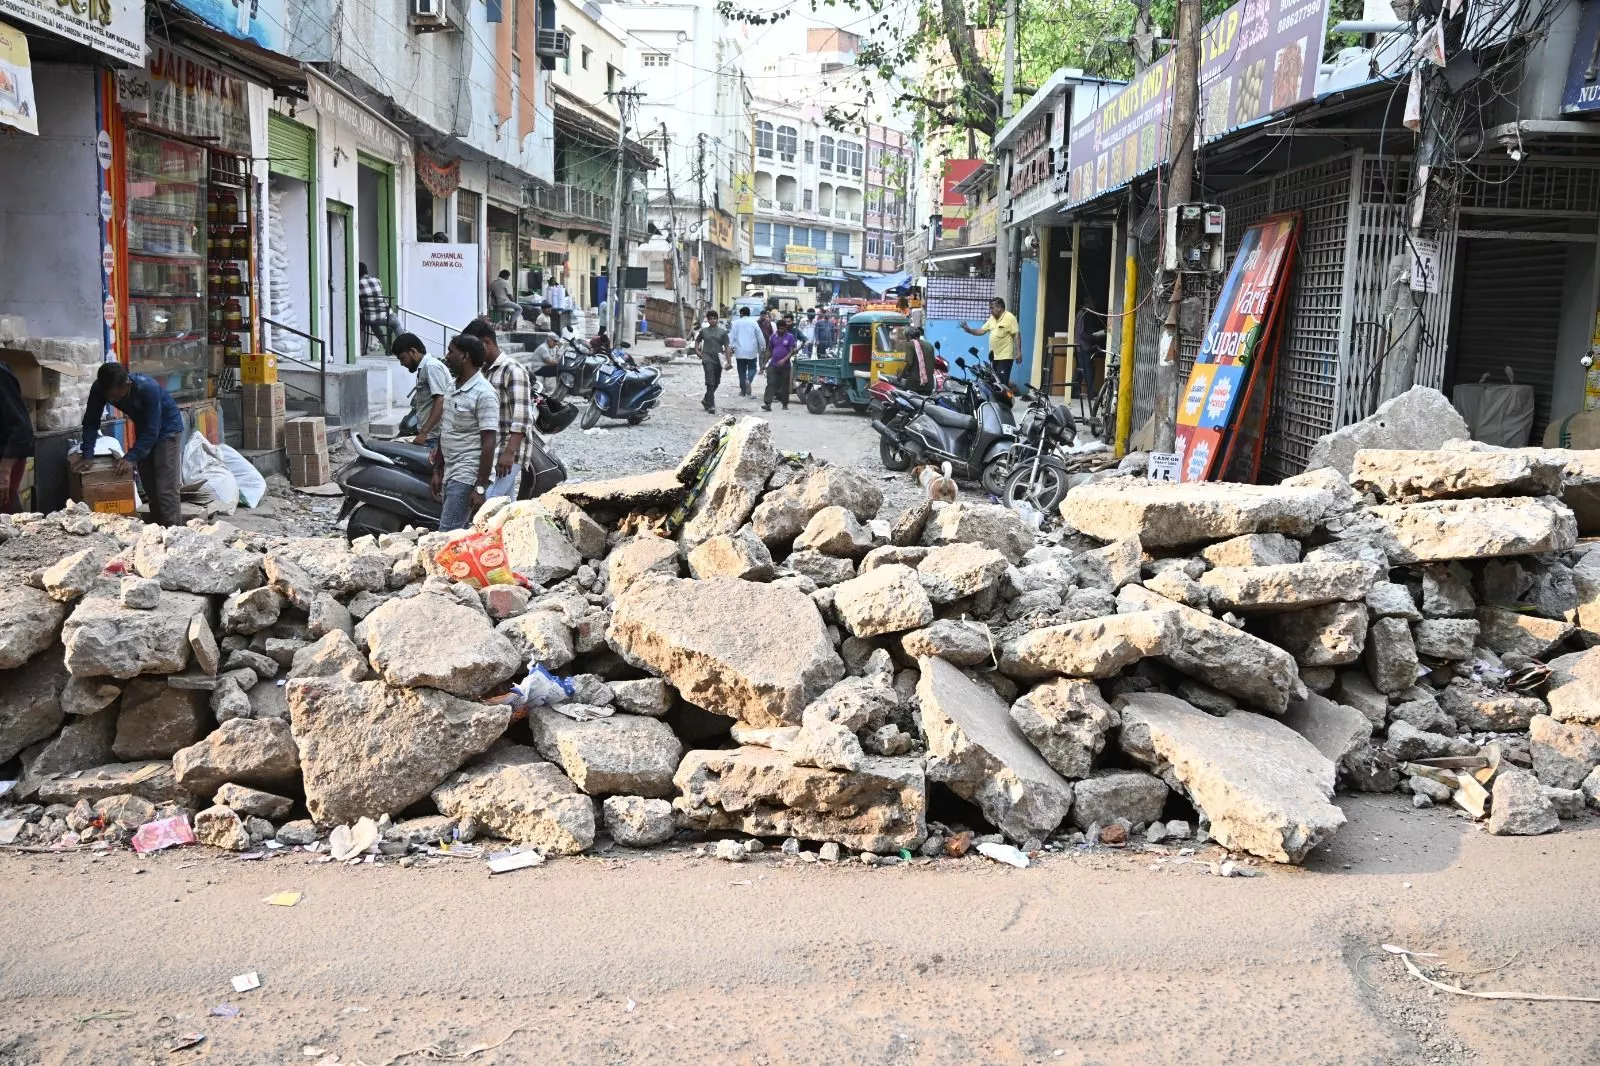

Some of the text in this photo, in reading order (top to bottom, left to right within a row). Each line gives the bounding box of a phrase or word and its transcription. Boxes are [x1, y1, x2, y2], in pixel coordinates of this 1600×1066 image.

[90, 24, 105, 37] HOTEL
[106, 31, 116, 41] RAW
[117, 36, 141, 51] MATERIALS
[1209, 10, 1238, 60] LLP
[150, 48, 182, 84] JAI
[1119, 81, 1140, 121] NUTS
[1141, 64, 1164, 109] AND
[1578, 85, 1600, 102] NU
[422, 260, 449, 268] DAYARAM
[431, 252, 464, 260] MOHANLAL
[1203, 322, 1251, 362] Supari
